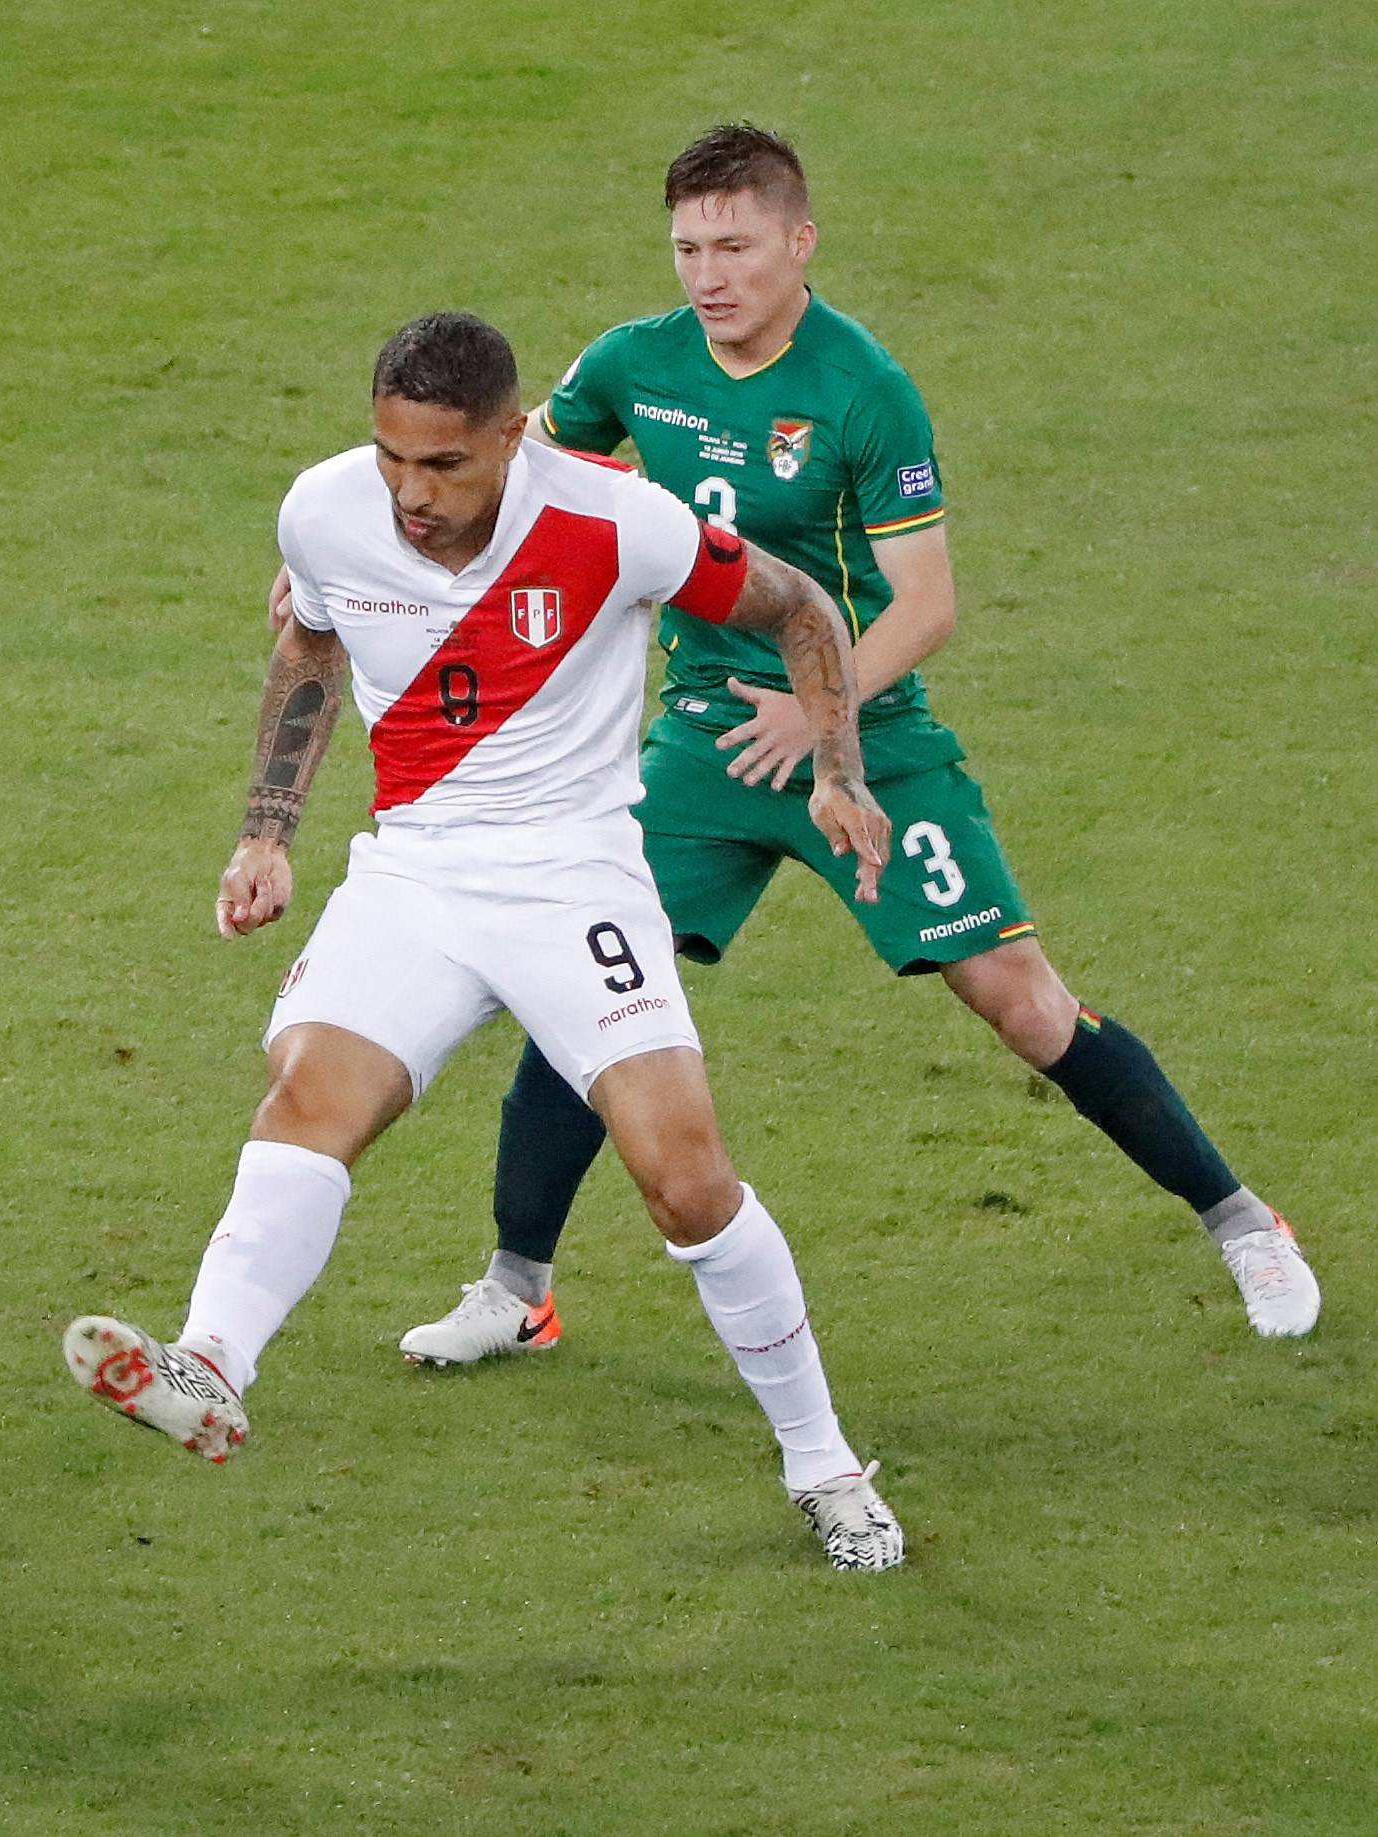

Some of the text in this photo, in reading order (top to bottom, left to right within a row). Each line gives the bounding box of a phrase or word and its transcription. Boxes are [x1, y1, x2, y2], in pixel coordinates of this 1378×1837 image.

[633, 402, 709, 432] marathon
[694, 476, 738, 537] 3
[346, 598, 429, 616] marathon
[438, 664, 479, 727] 9
[901, 820, 967, 908] 3
[919, 906, 1002, 942] marathon
[585, 921, 645, 995] 9
